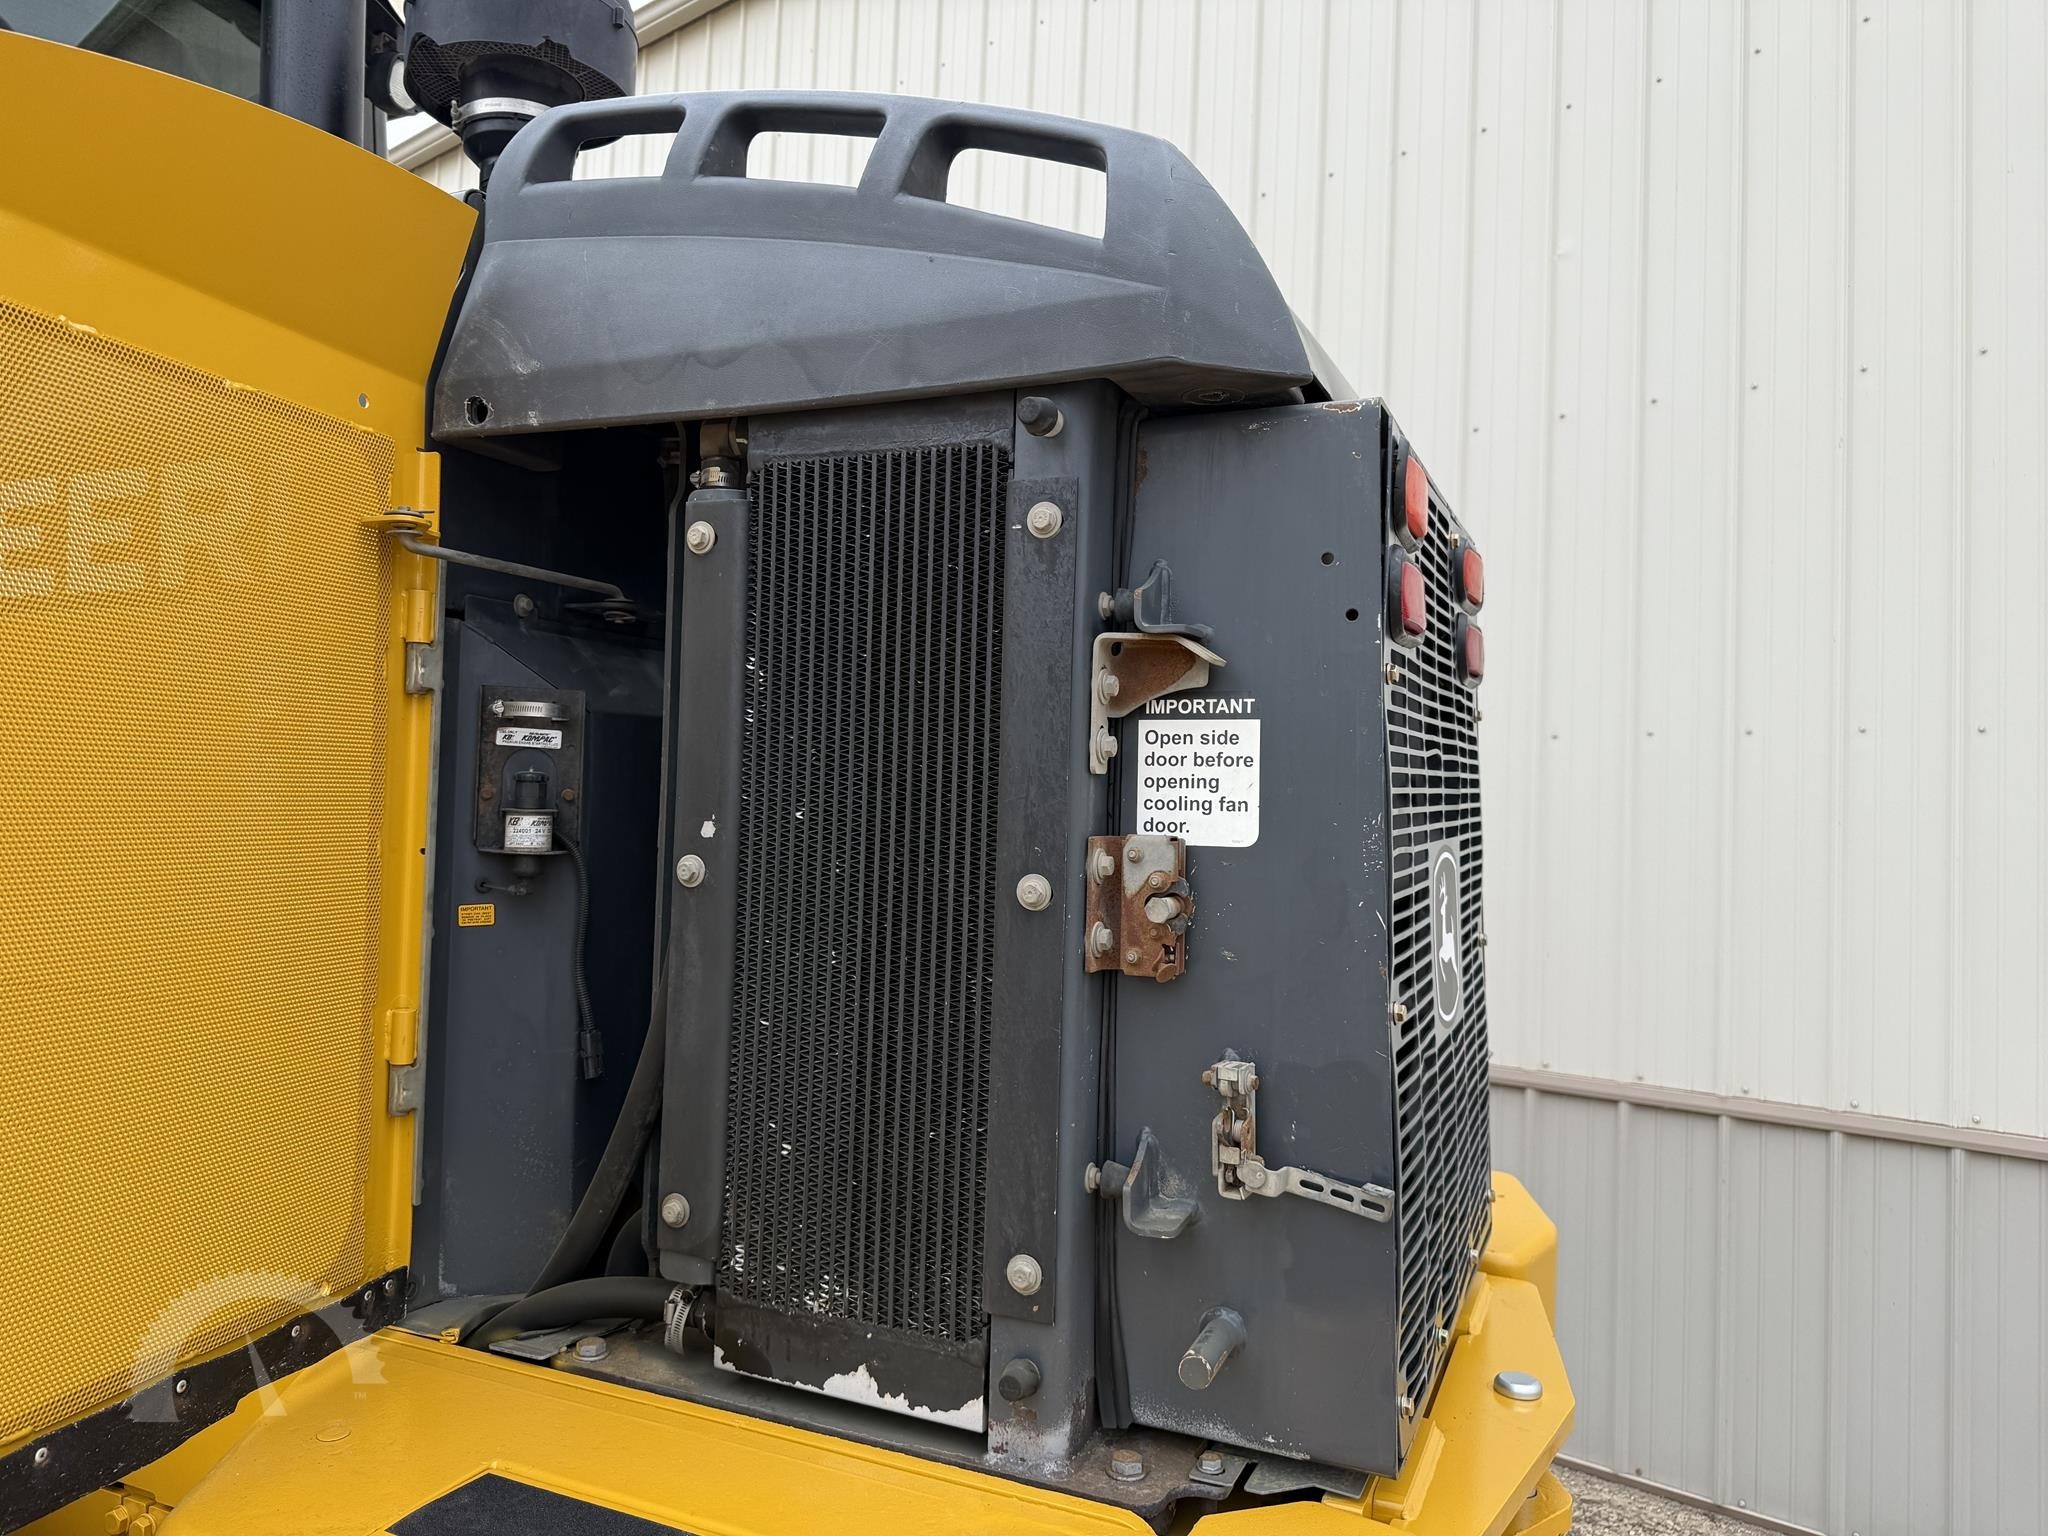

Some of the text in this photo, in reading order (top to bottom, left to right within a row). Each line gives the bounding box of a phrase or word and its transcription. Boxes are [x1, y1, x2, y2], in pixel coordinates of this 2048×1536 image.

[1145, 698, 1255, 714] IMPORTANT
[1144, 729, 1240, 749] Open side
[1144, 751, 1254, 768] door before
[1143, 773, 1220, 793] opening
[1143, 795, 1249, 816] cooling fan
[1143, 816, 1190, 833] door.
